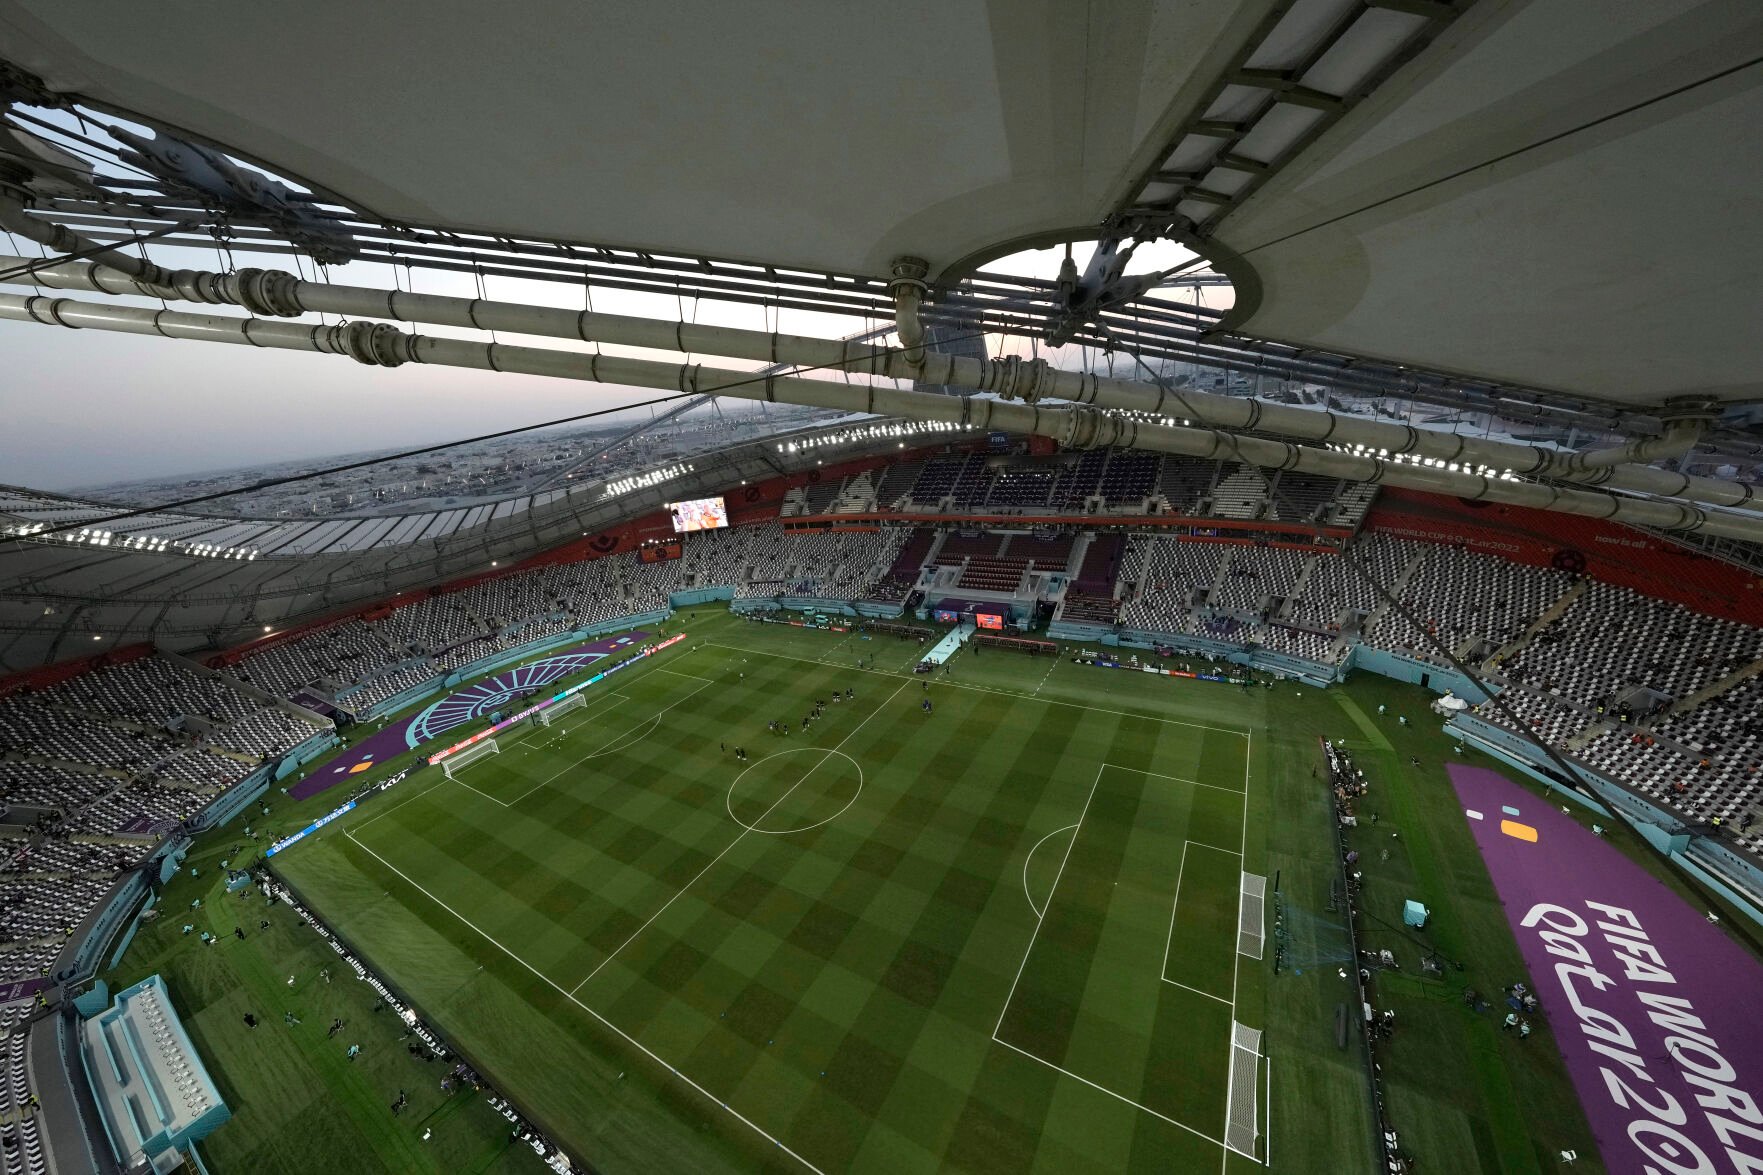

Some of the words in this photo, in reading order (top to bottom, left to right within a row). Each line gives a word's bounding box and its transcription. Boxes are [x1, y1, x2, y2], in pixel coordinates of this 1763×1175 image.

[1394, 528, 1426, 537] WORLD
[1428, 531, 1445, 540] CUP
[1621, 537, 1630, 546] is
[1632, 540, 1647, 549] all
[281, 832, 305, 848] WANDA
[1520, 903, 1718, 1175] Qatar20
[1585, 899, 1677, 984] FIFA
[1636, 991, 1763, 1175] WORL
